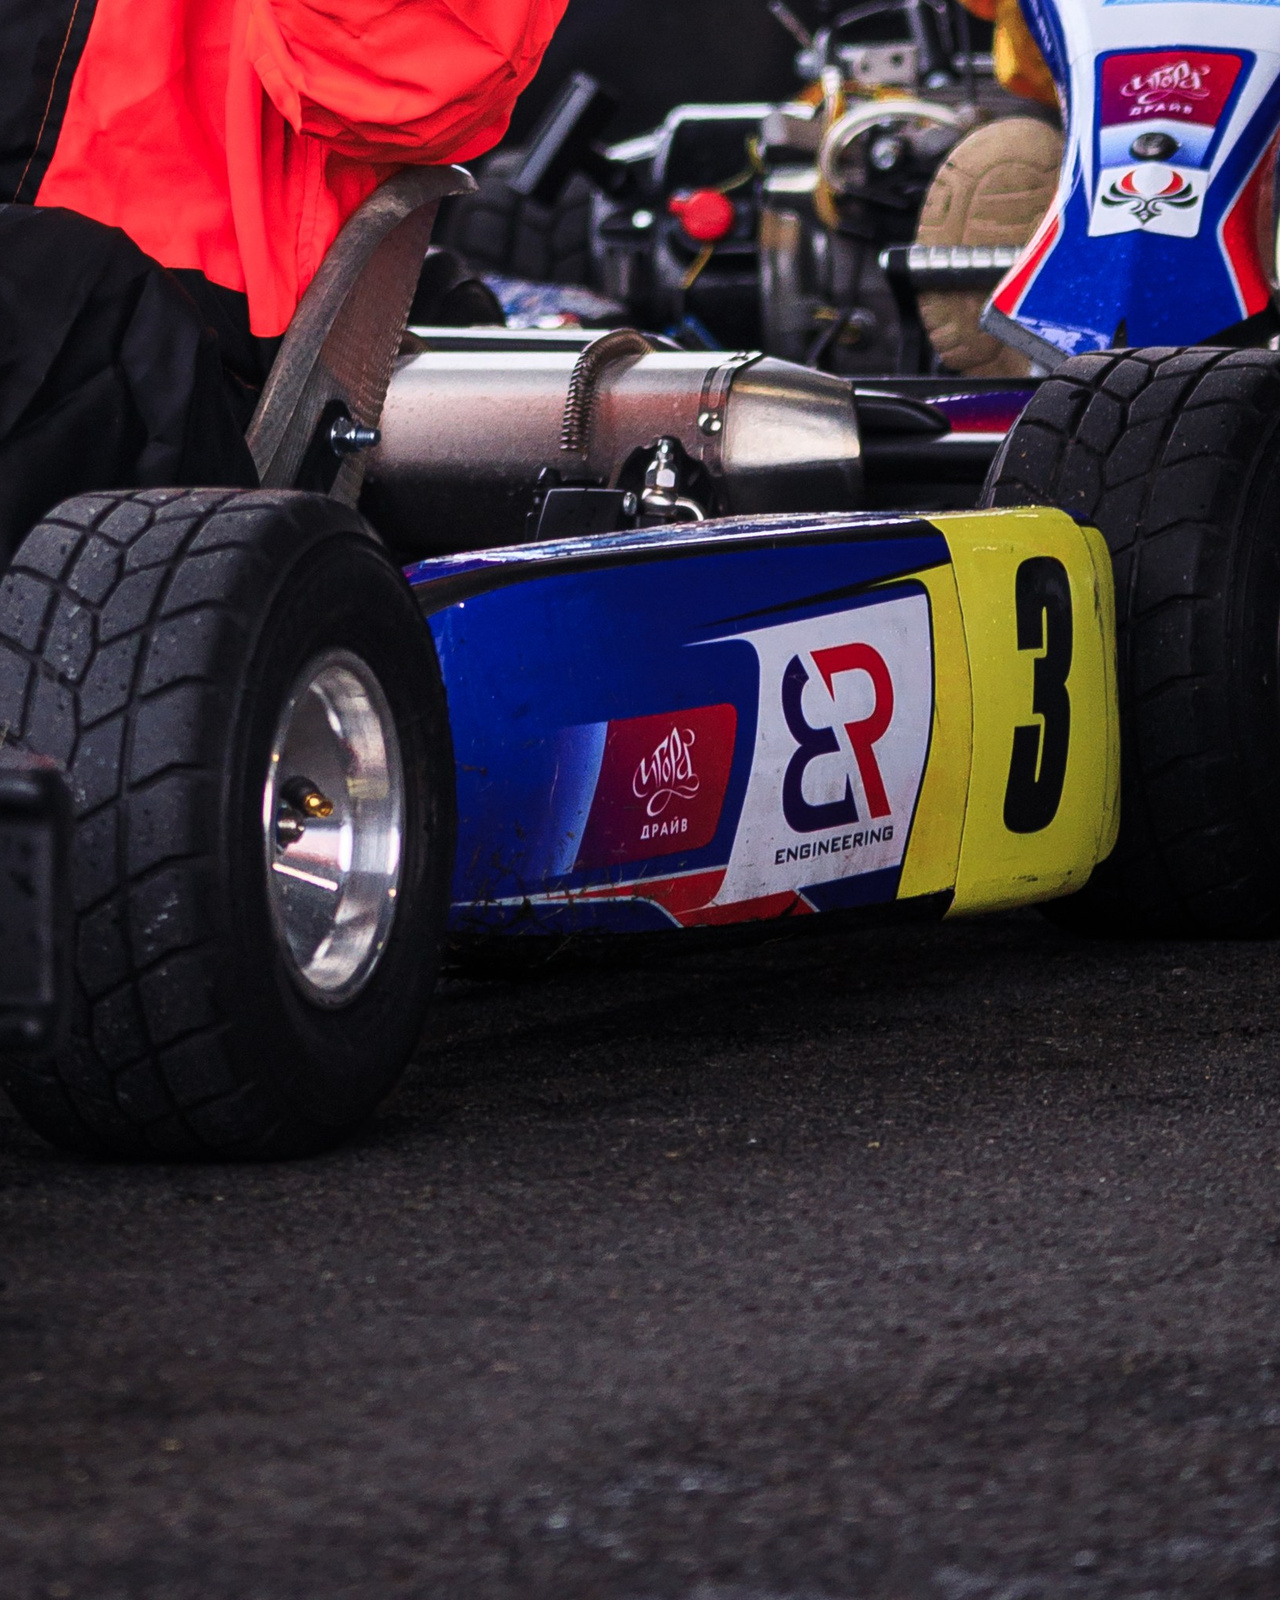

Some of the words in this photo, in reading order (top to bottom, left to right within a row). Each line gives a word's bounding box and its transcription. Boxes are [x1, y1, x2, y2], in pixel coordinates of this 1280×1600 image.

[1003, 555, 1073, 834] 3
[639, 816, 689, 840] ДРАЙВ
[774, 824, 894, 866] ENGINEERING
